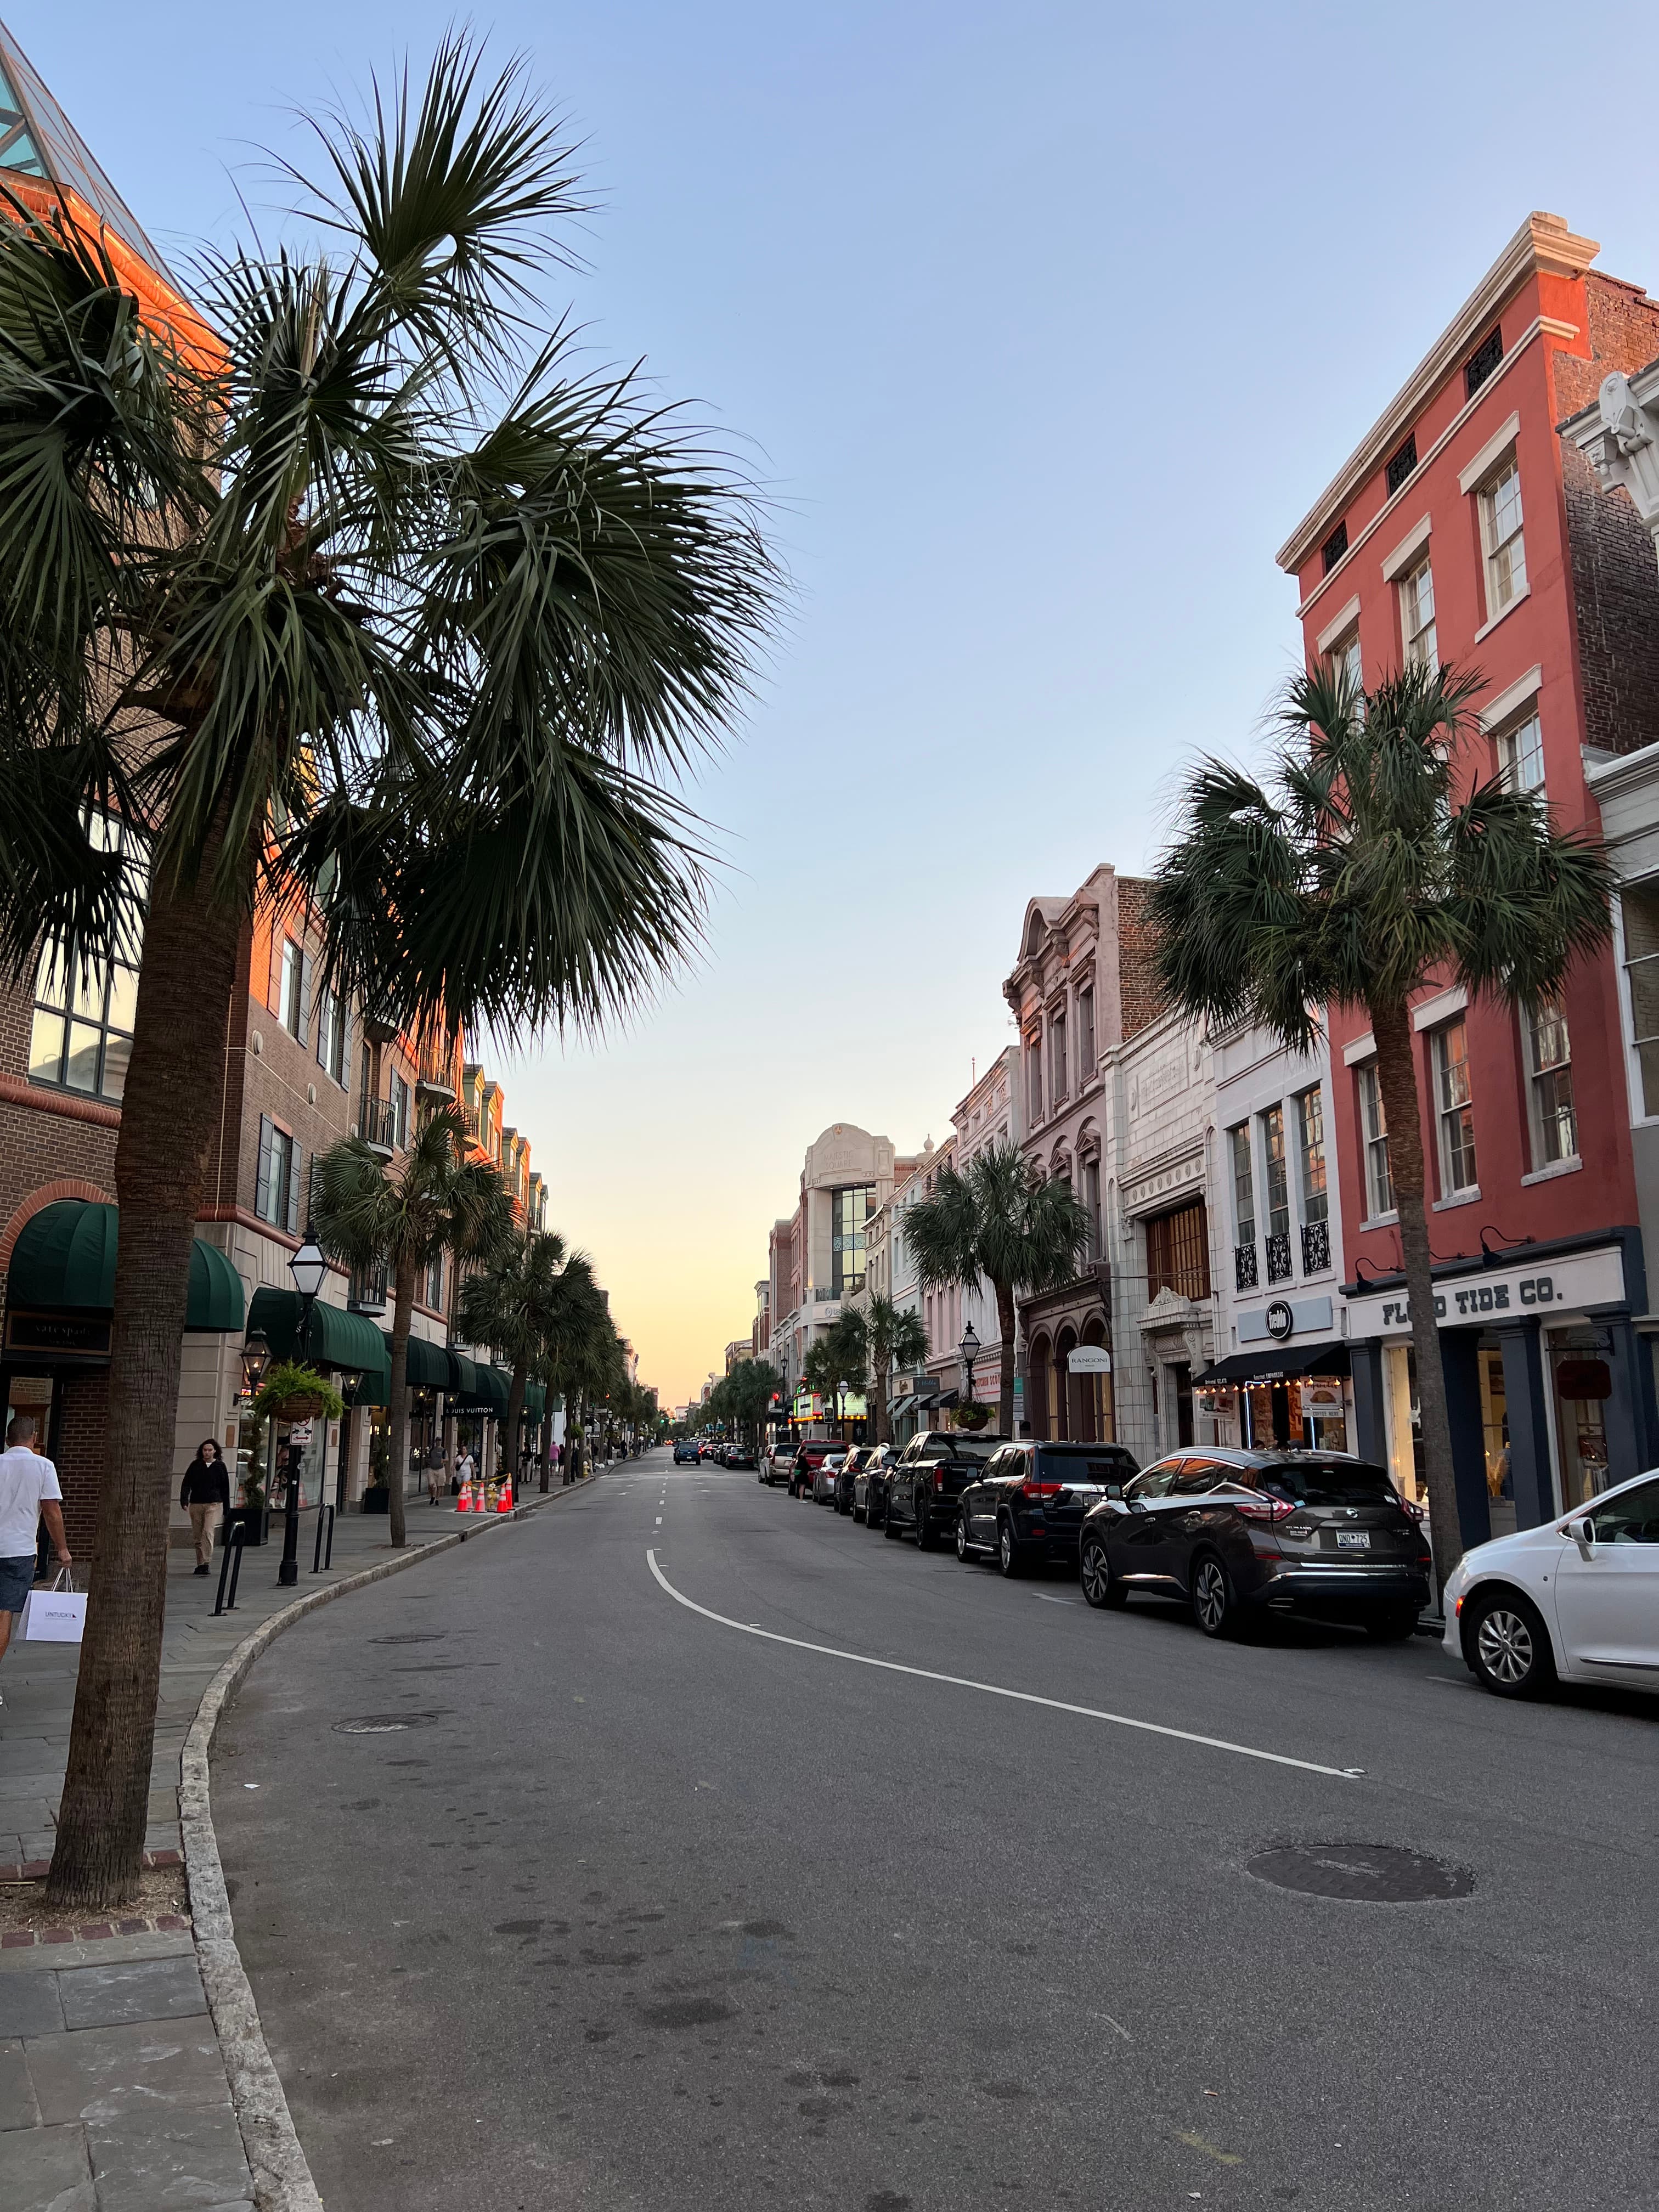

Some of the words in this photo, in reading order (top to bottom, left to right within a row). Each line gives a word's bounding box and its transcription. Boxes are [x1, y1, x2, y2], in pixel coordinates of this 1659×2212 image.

[824, 1149, 852, 1161] MAJESTIC
[826, 1159, 852, 1170] SQUARE
[1382, 1295, 1446, 1325] FLD
[1455, 1284, 1510, 1314] TIDE
[1519, 1277, 1562, 1305] CO.
[1268, 1309, 1286, 1329] freddo
[1356, 1534, 1368, 1543] 725
